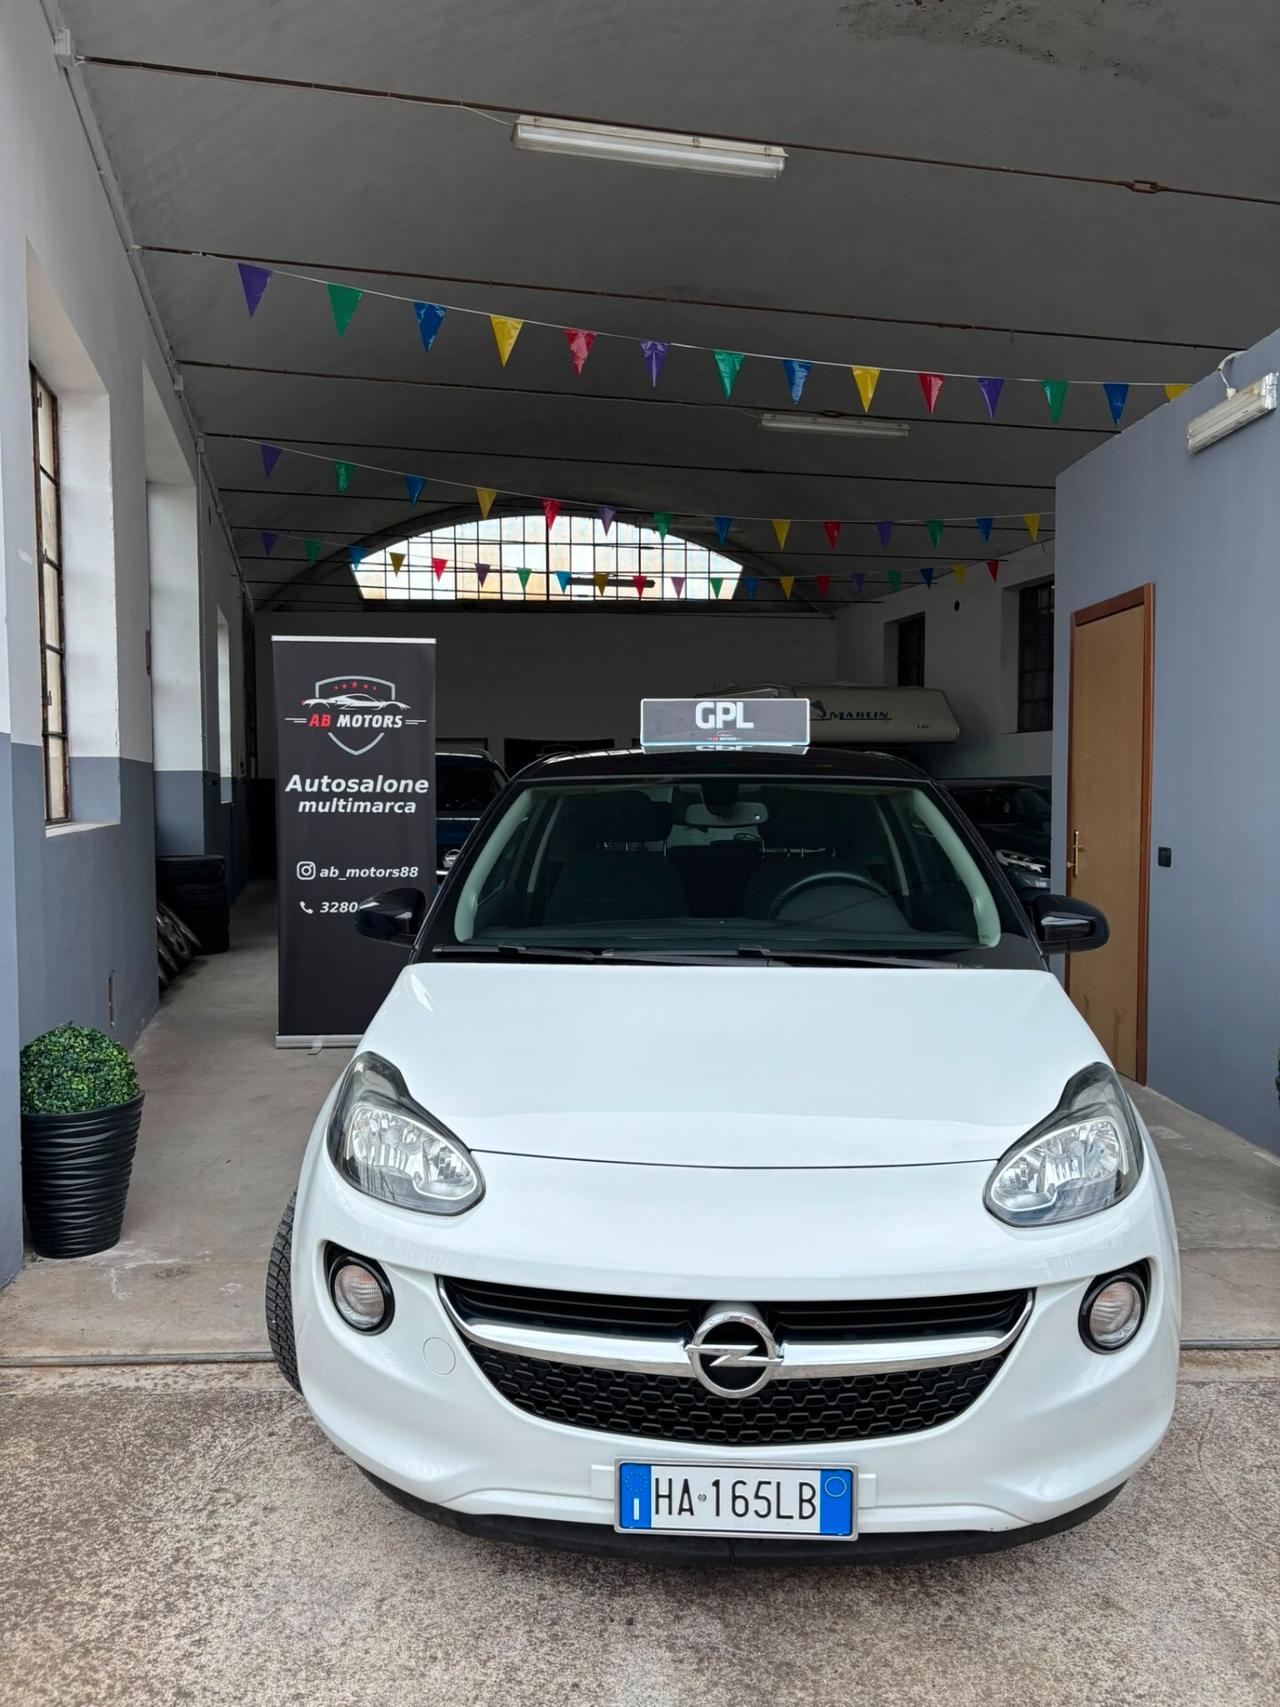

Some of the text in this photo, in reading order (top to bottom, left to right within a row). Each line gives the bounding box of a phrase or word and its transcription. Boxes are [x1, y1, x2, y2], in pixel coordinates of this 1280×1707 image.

[309, 714, 402, 728] AB MOTORS
[695, 702, 754, 729] GPL
[285, 774, 429, 793] Autosalone
[298, 798, 416, 813] multimarca
[320, 866, 418, 880] ab_motors88
[320, 901, 360, 913] 3280
